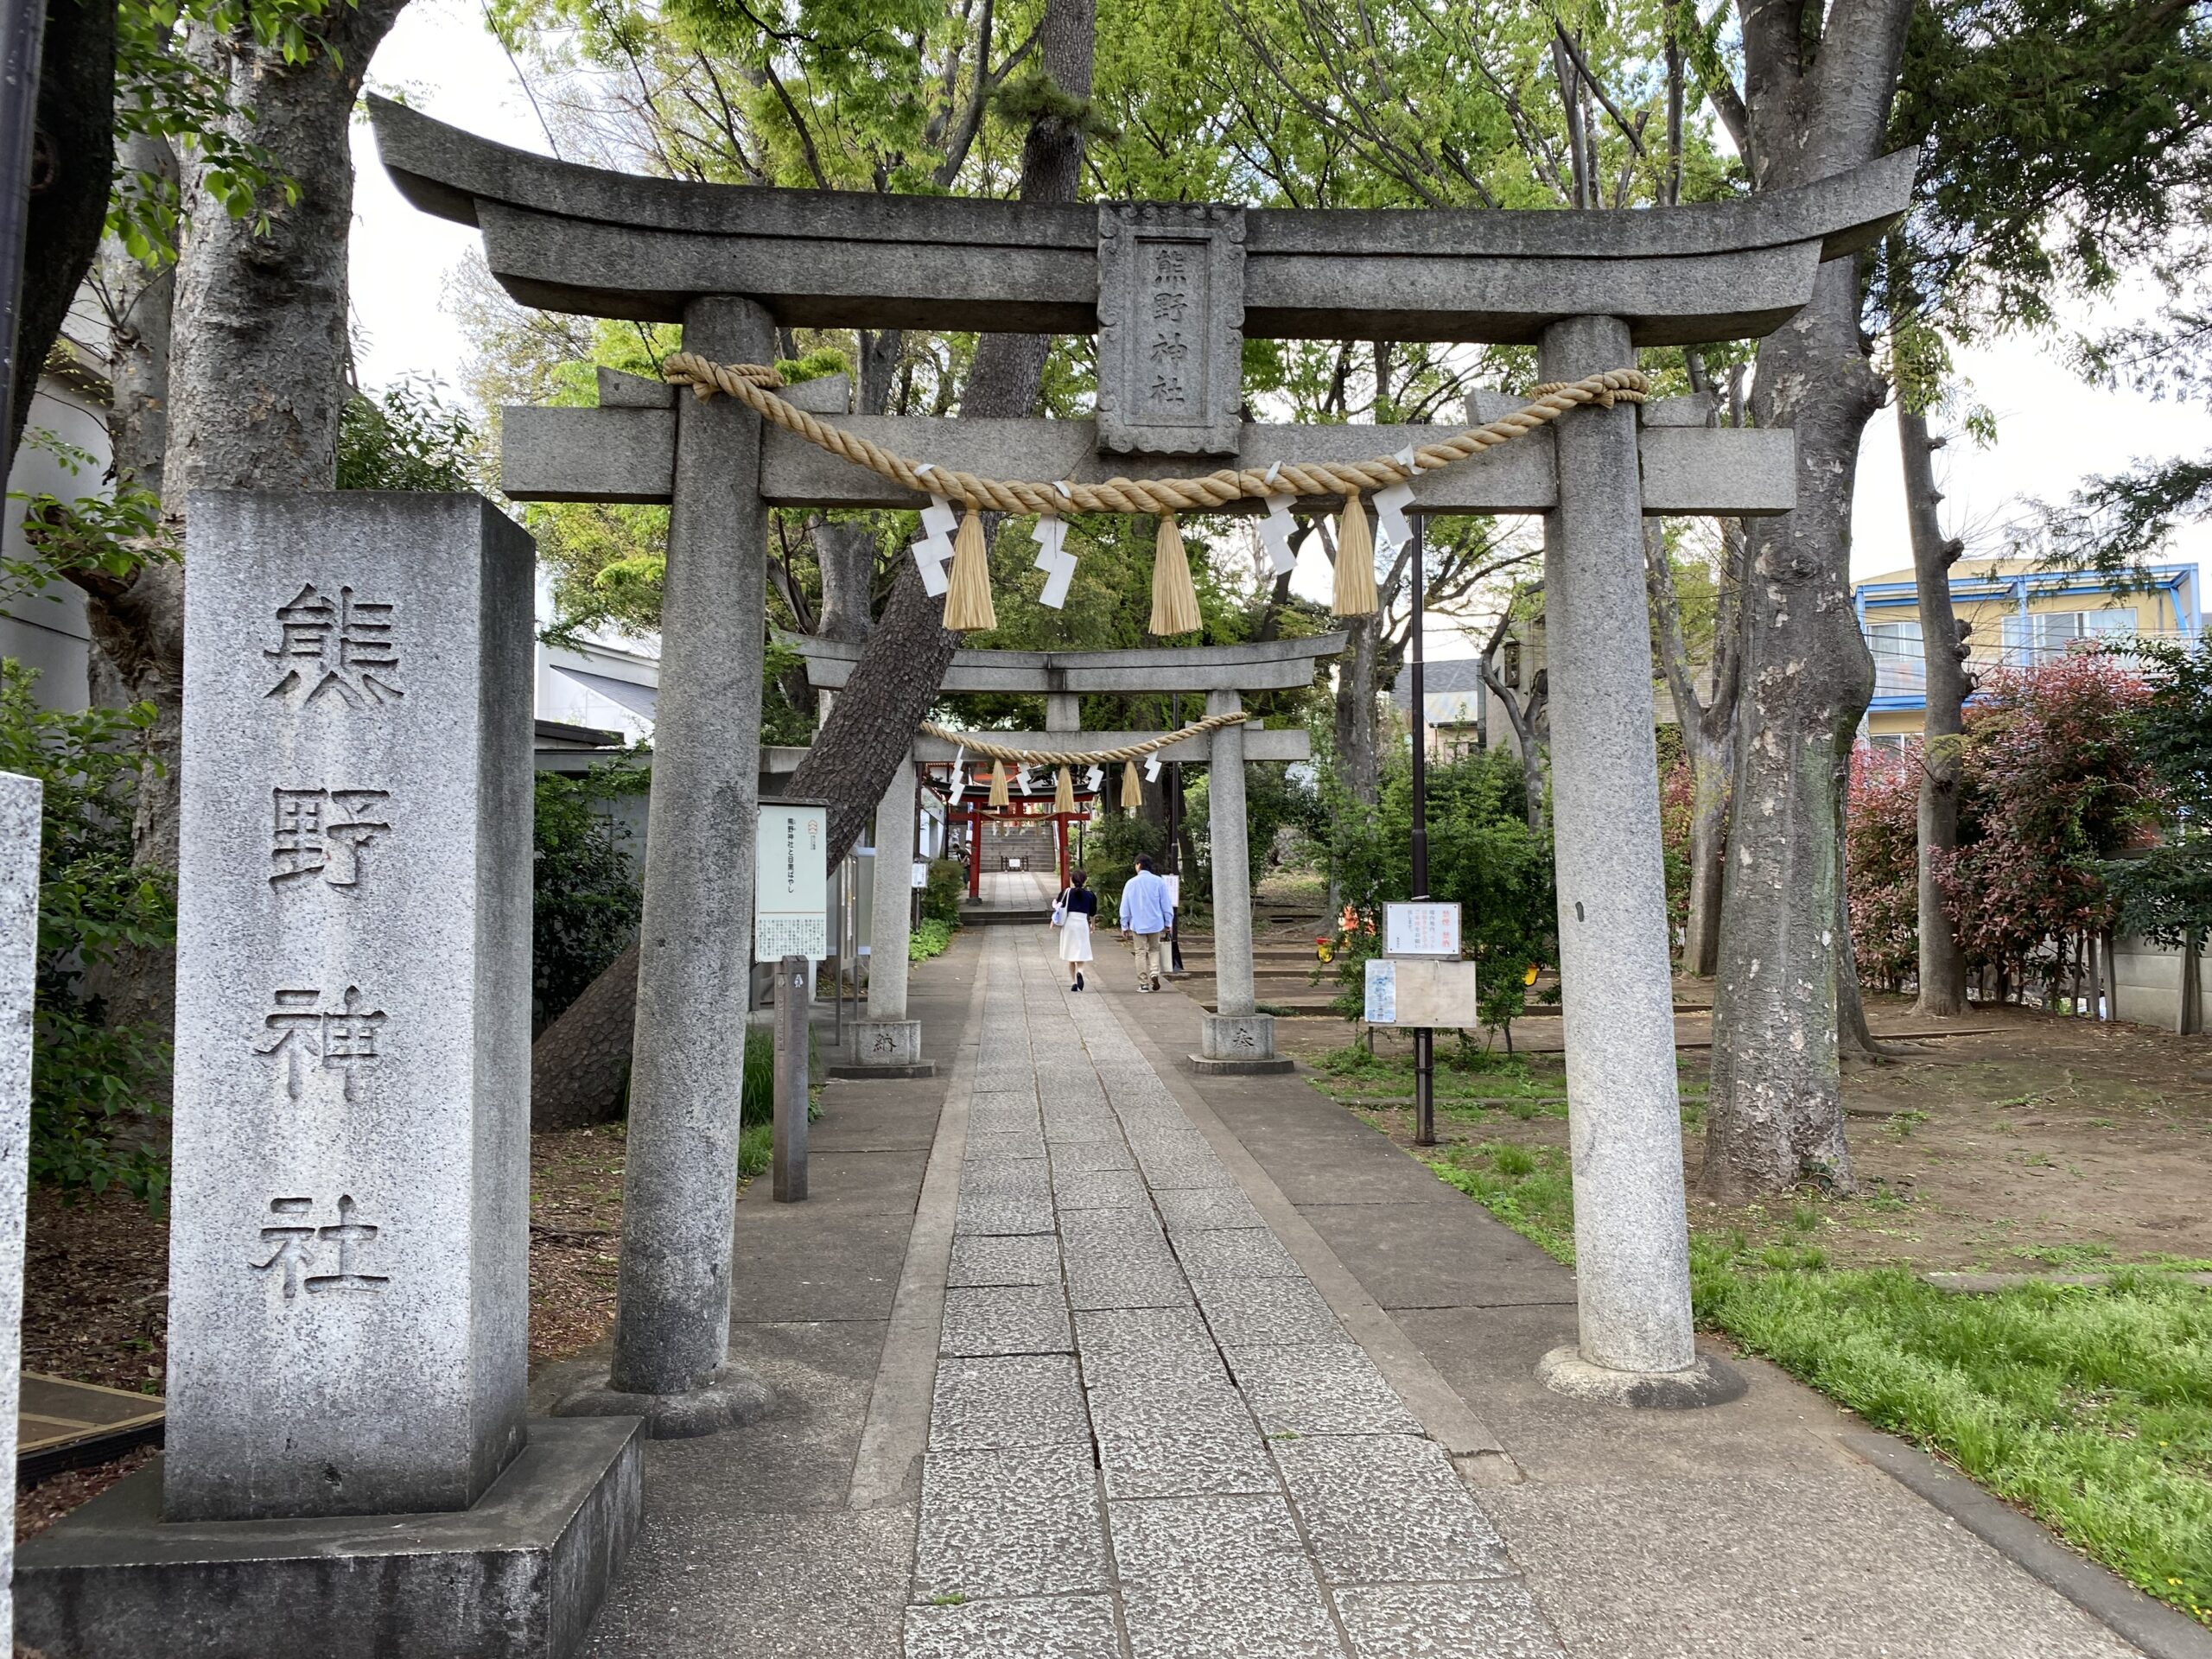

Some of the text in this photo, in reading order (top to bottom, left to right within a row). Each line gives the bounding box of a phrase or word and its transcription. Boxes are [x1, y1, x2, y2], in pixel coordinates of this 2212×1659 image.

[1150, 250, 1188, 408] 熊野神社
[251, 582, 404, 1300] 熊野神社
[874, 1033, 897, 1052] 納
